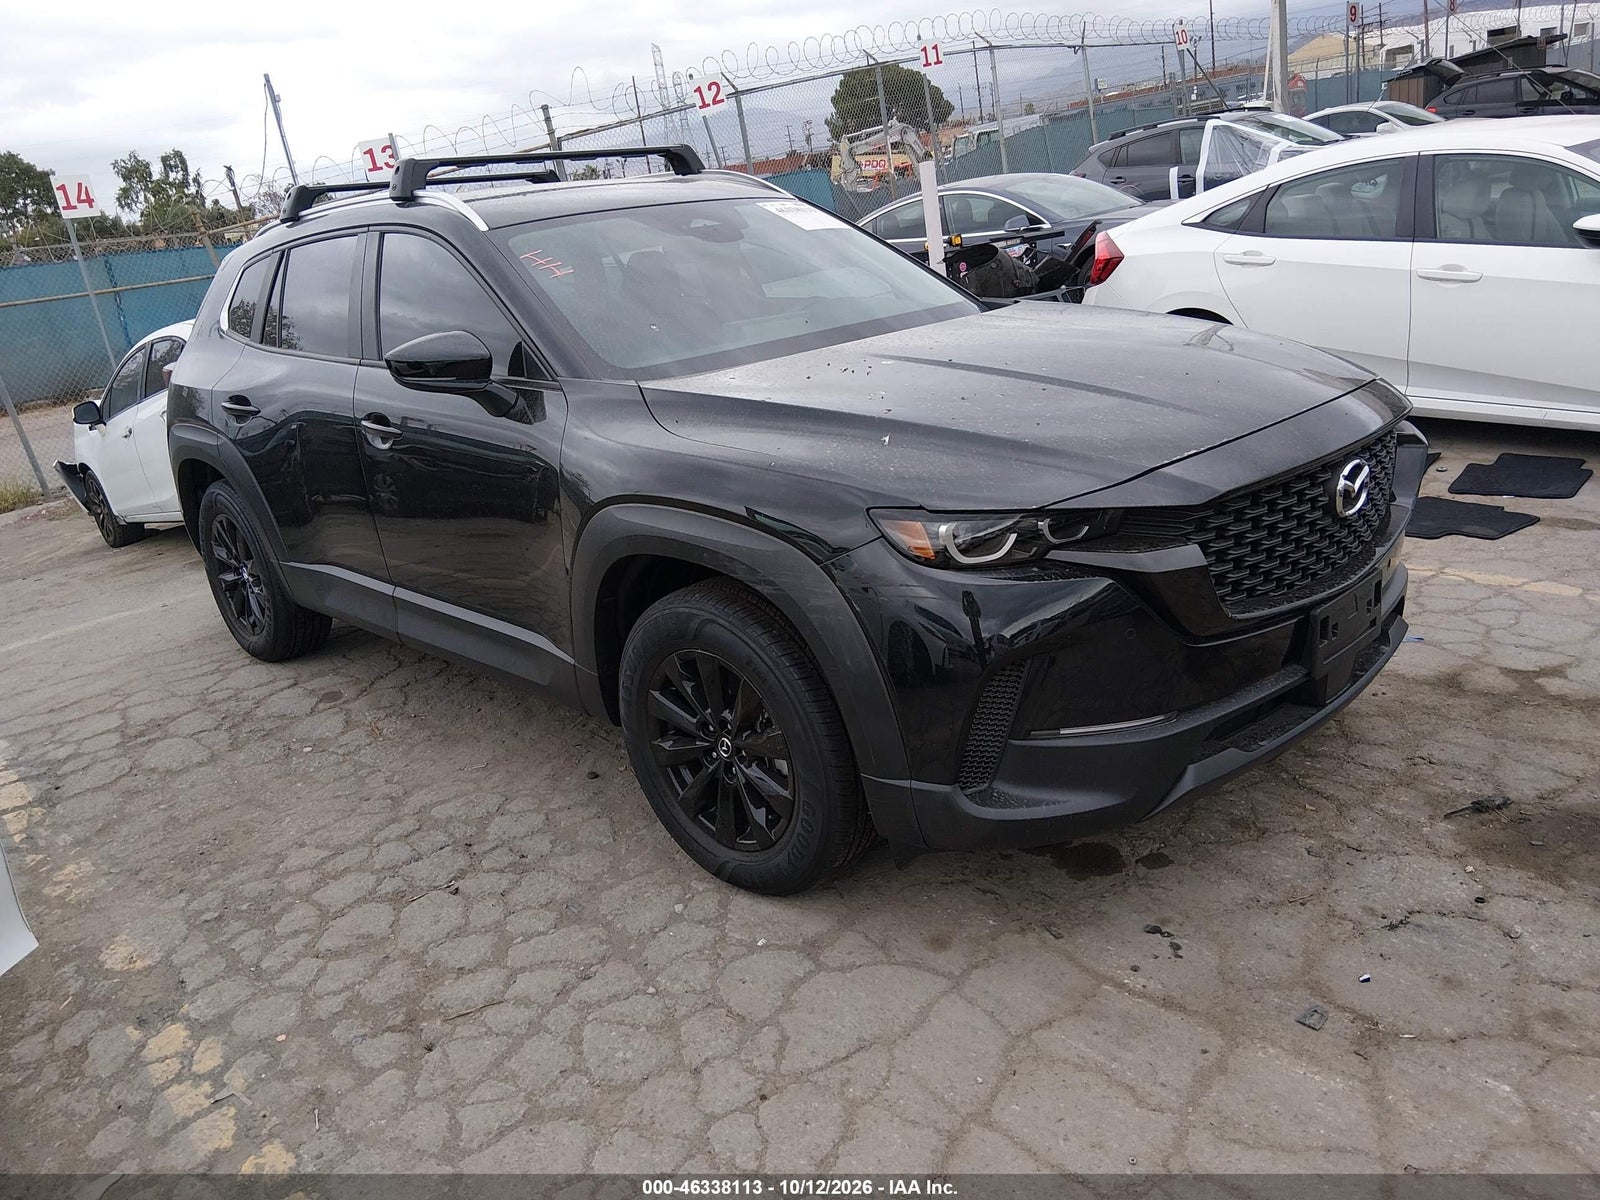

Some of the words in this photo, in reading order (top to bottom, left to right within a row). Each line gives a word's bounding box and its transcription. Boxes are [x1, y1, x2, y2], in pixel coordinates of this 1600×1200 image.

[1350, 5, 1357, 22] 9
[1175, 29, 1188, 45] 10
[920, 44, 943, 68] 11
[693, 81, 725, 109] 12
[362, 144, 396, 173] 13
[864, 159, 886, 169] PDQ
[55, 182, 95, 210] 14
